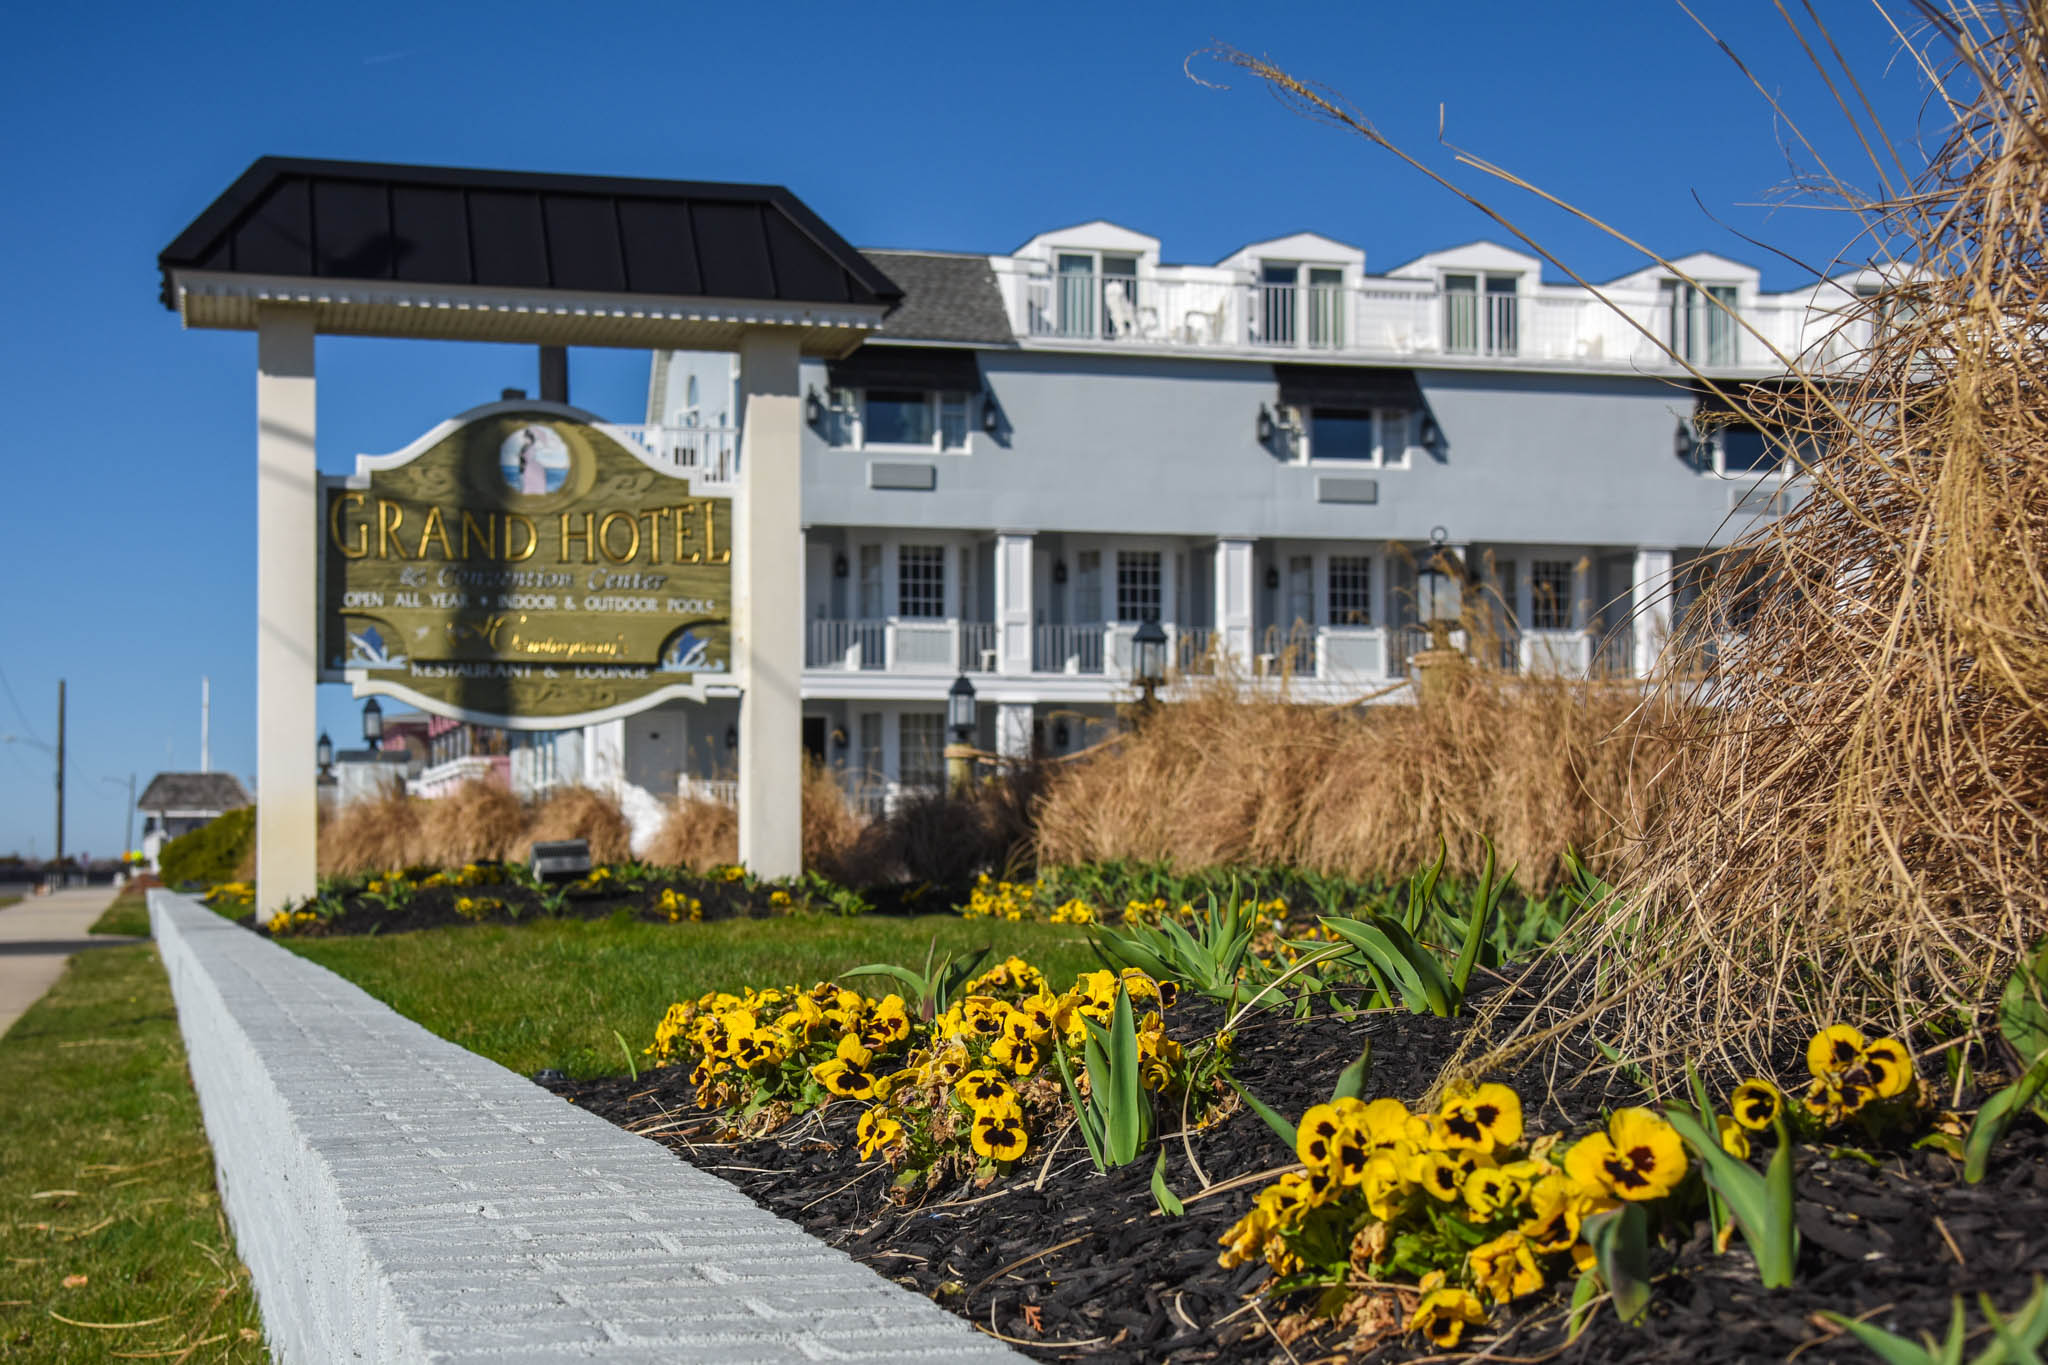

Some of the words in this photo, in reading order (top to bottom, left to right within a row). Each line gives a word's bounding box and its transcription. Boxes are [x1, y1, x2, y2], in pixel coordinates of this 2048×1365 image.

[331, 490, 537, 562] GRAND
[558, 501, 731, 564] HOTEL
[400, 566, 427, 588] &
[588, 567, 667, 592] Center
[343, 591, 385, 607] OPEN
[394, 592, 422, 608] ALL
[429, 592, 468, 608] YEAR
[497, 594, 557, 610] INDOOR
[565, 596, 577, 611] &
[584, 596, 658, 612] OUTDOOR
[667, 597, 716, 614] POOLS
[411, 661, 532, 678] RESTAURANT
[543, 666, 560, 679] &
[574, 664, 649, 679] LOUNGE
